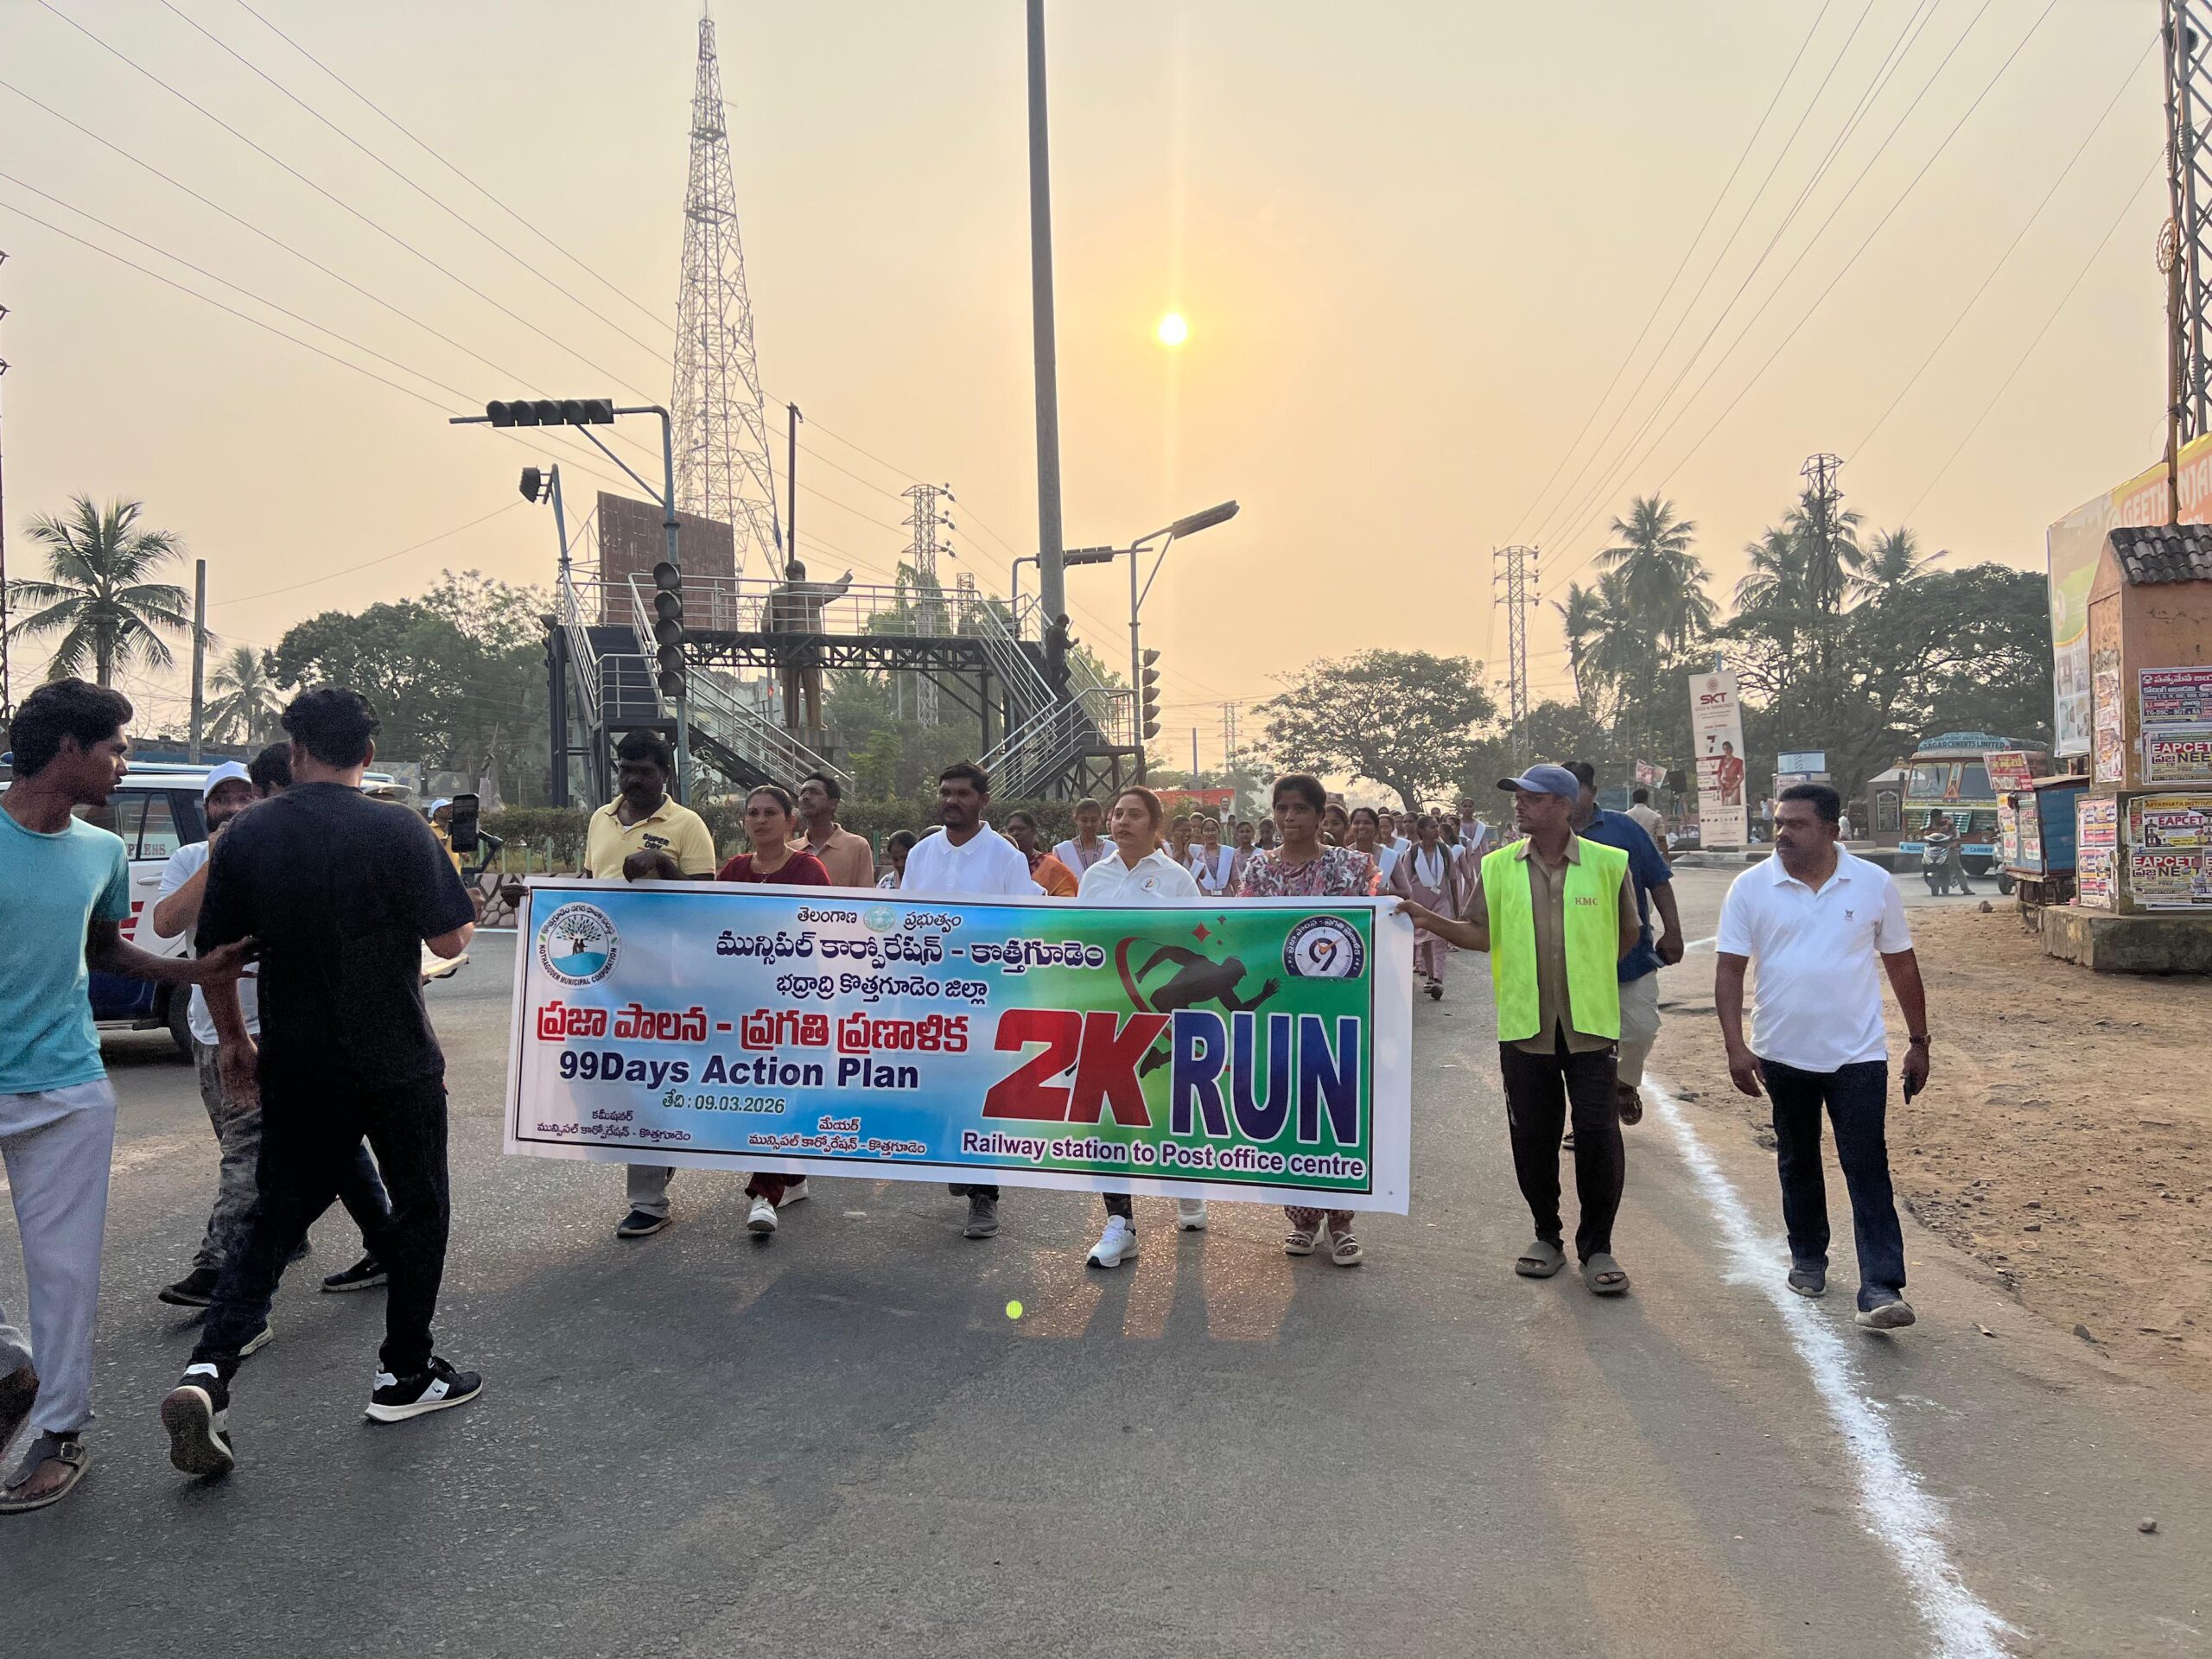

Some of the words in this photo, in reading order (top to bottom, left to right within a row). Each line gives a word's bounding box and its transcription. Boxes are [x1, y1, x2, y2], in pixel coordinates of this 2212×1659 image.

[1700, 692, 1727, 705] SKT
[1976, 741, 2005, 749] LIMITED
[2152, 741, 2212, 753] EAPCET
[2158, 816, 2203, 825] EAPCET
[642, 833, 670, 846] SUPER
[2133, 856, 2196, 867] EAPCET
[1575, 897, 1599, 906] KMC
[798, 907, 857, 924] తెలంగాణ
[904, 911, 962, 932] ప్రభుత్వం
[971, 941, 1105, 974] కొత్తగూడెం
[1309, 938, 1338, 972] 9
[539, 944, 561, 982] KOTHAGUDEM
[560, 976, 591, 986] MUNICIPAL
[591, 947, 618, 983] CORPORATION
[777, 973, 836, 1000] భద్రాద్రి
[839, 976, 939, 1002] కొత్తగూడెం
[945, 979, 988, 1006] జిల్లా
[537, 1001, 607, 1042] ప్రజా
[613, 1003, 707, 1041] పాలన
[741, 1007, 830, 1051] ప్రగతి
[837, 1012, 968, 1054] ప్రణాళిక
[559, 1051, 690, 1090] 99Days
[701, 1055, 823, 1087] Action
[837, 1057, 919, 1089] Plan
[1170, 1007, 1362, 1147] RUN
[695, 1095, 786, 1114] 09.03.2026
[819, 1116, 860, 1132] మేయర్
[639, 1128, 690, 1142] కొత్తగూడెం
[868, 1140, 925, 1156] కొత్తగూడెం
[963, 1129, 1046, 1162] Railway
[1051, 1137, 1126, 1163] station
[1133, 1141, 1155, 1164] to
[1161, 1145, 1214, 1168] Post
[1219, 1147, 1284, 1172] office
[1290, 1154, 1364, 1178] centre
